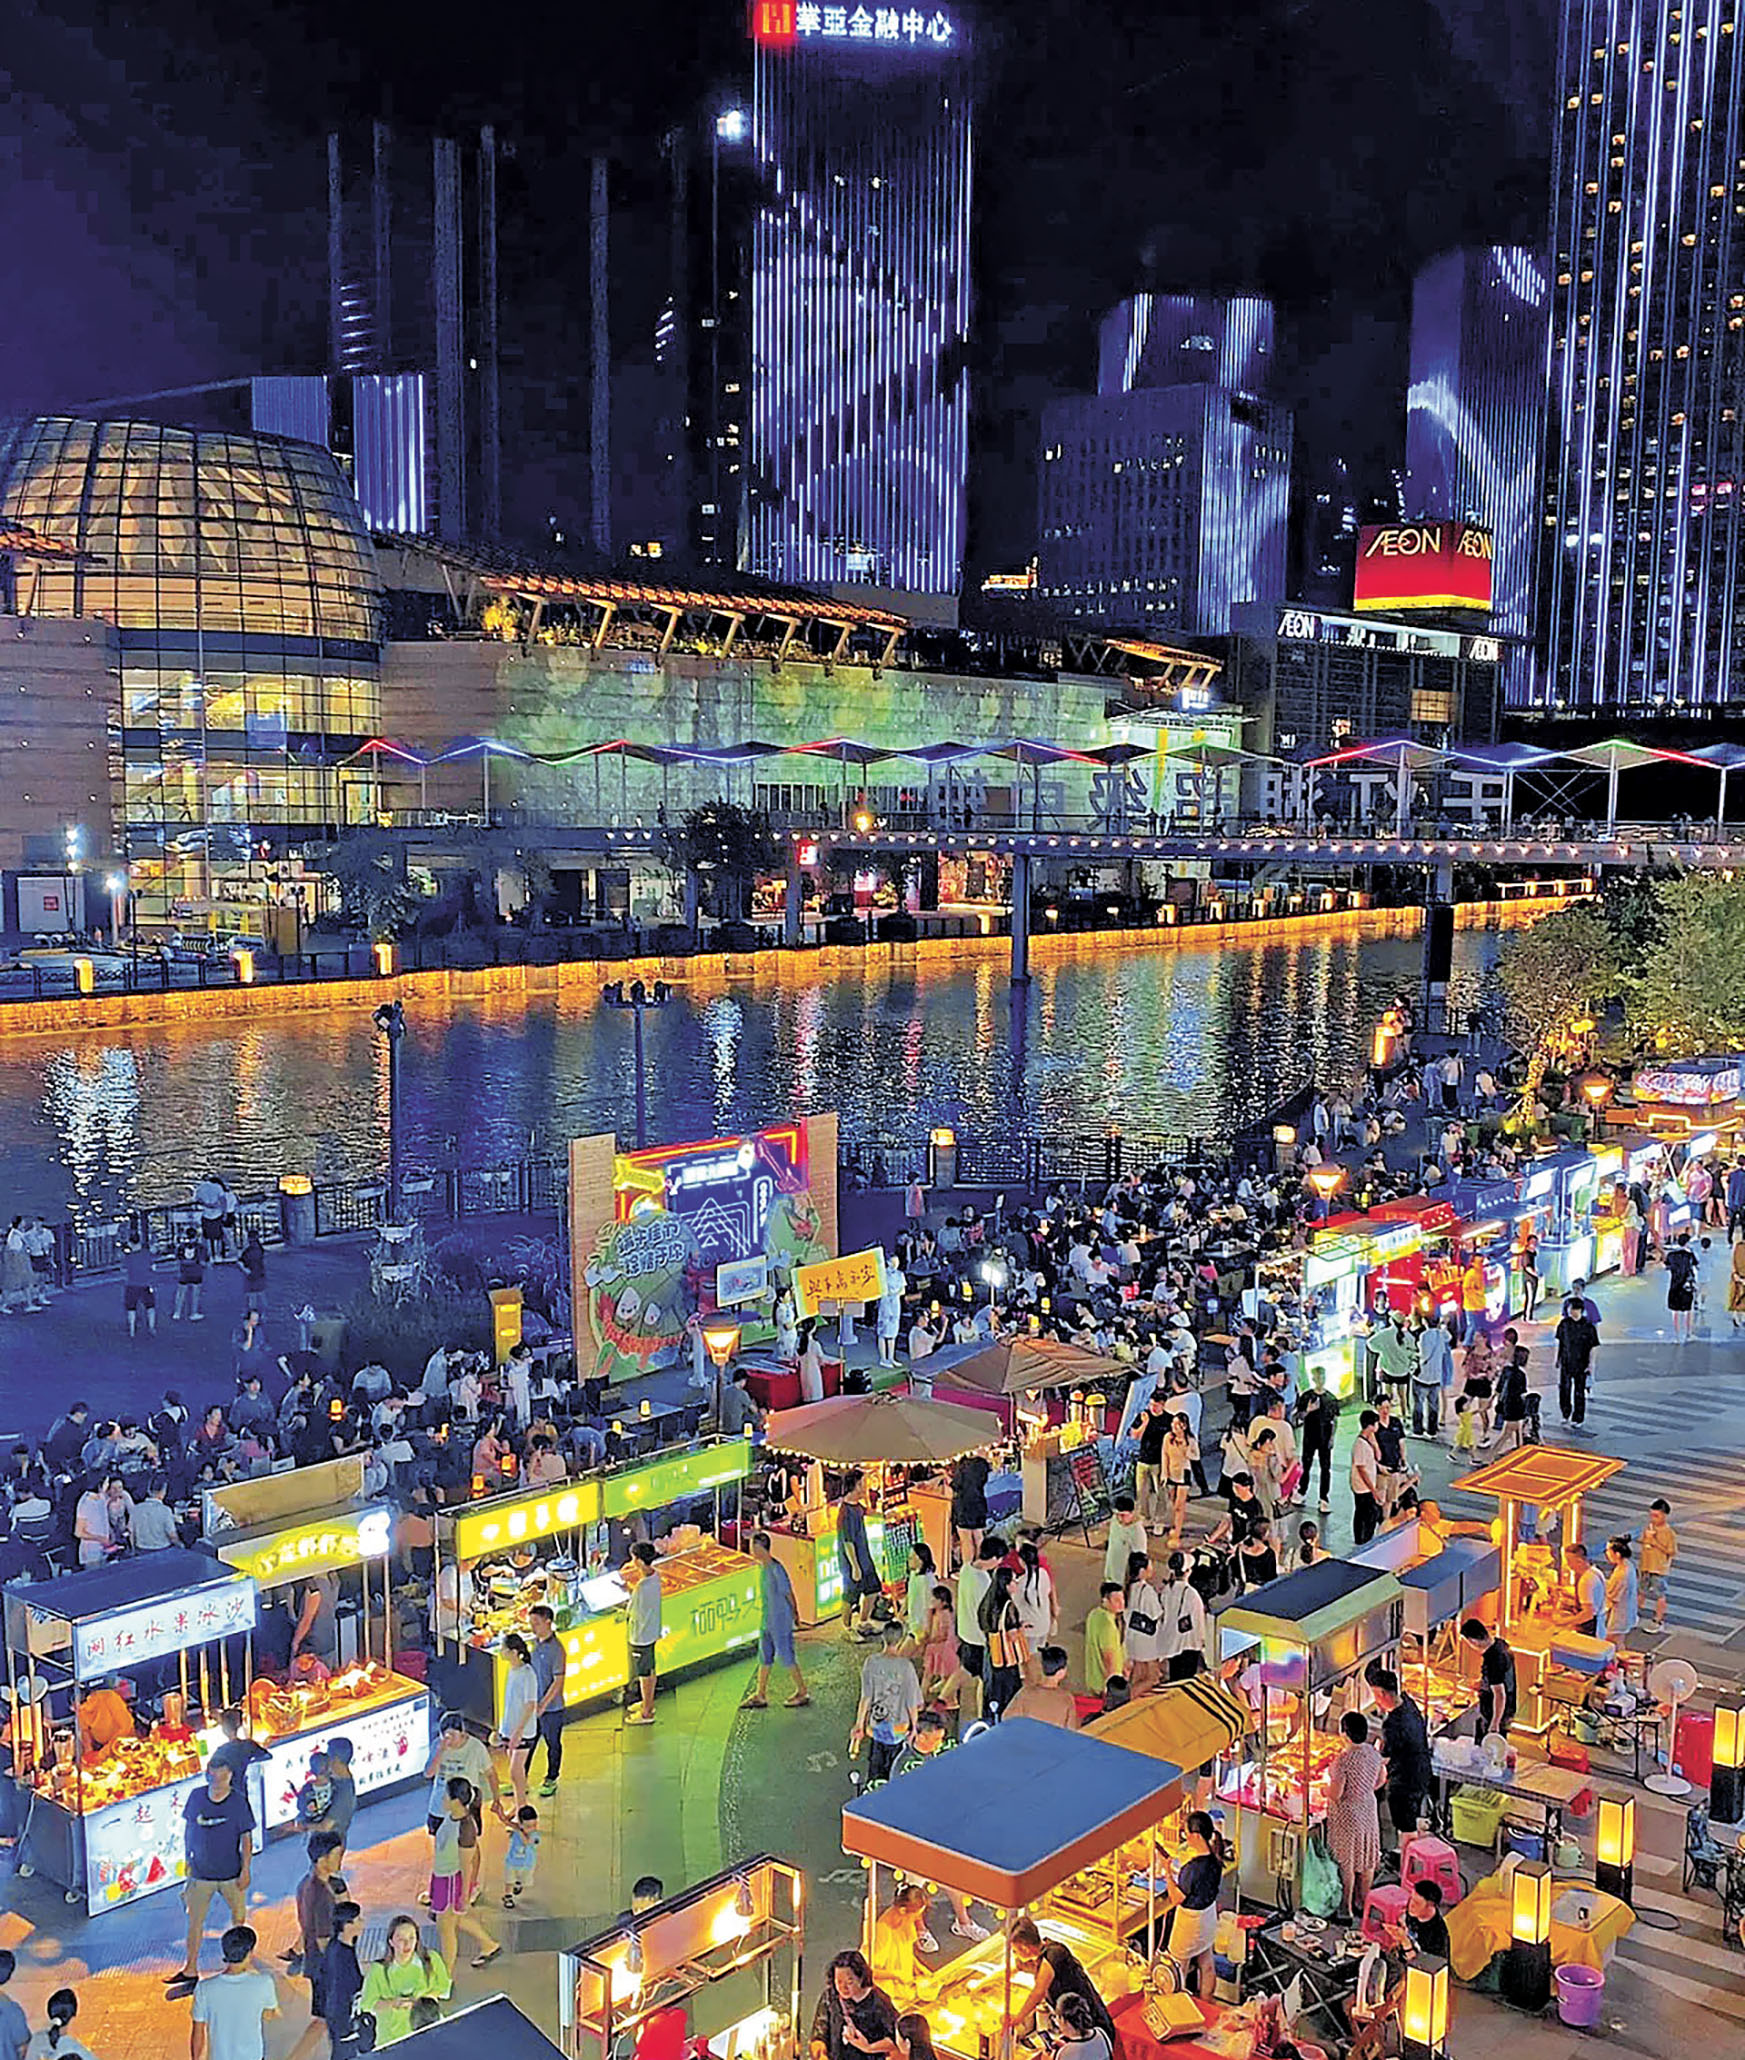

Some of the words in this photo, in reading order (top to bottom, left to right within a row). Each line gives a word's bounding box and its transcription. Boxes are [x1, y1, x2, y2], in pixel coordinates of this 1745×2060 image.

[796, 1, 953, 43] 華亞金融中心
[86, 1596, 245, 1657] 网红水果冰沙
